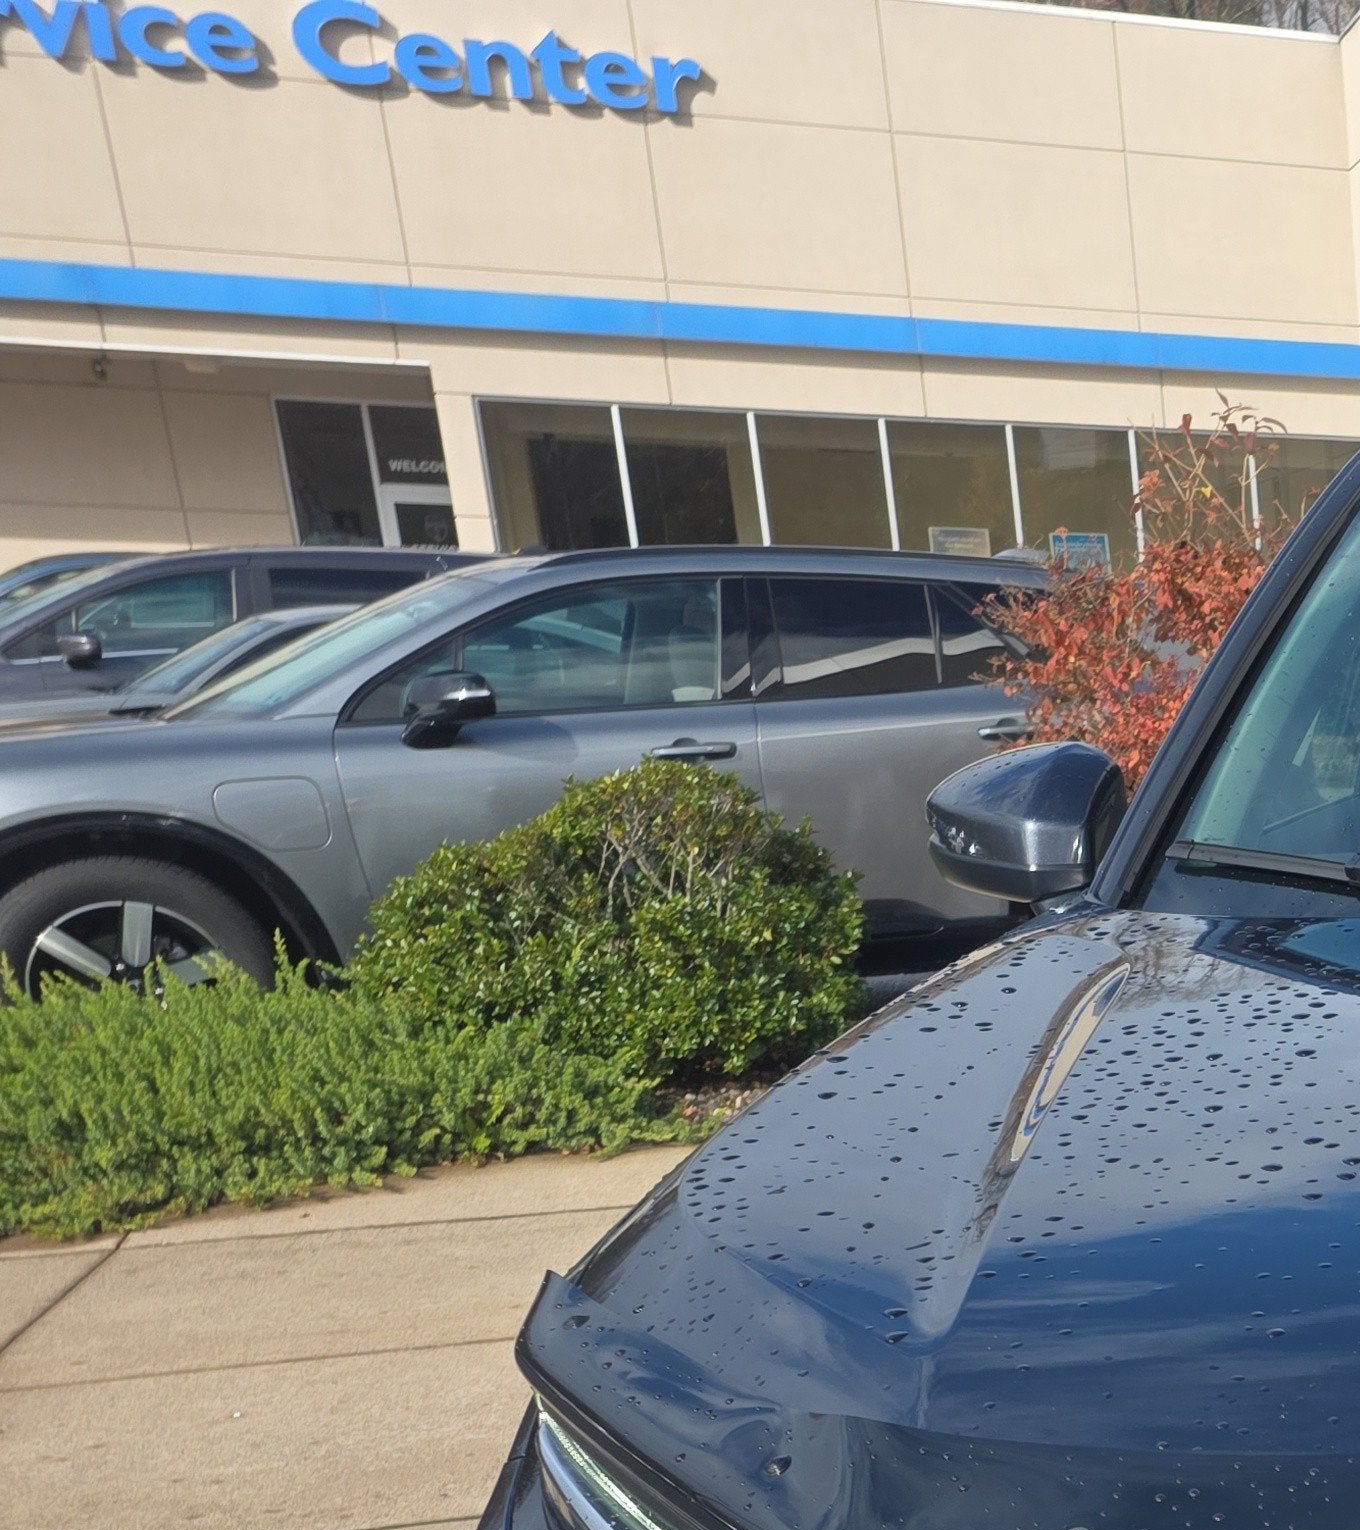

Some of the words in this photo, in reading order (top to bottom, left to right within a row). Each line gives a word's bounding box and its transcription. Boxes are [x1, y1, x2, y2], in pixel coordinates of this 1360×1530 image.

[0, 0, 259, 74] vice
[292, 0, 701, 113] Center
[388, 459, 446, 474] WELCO
